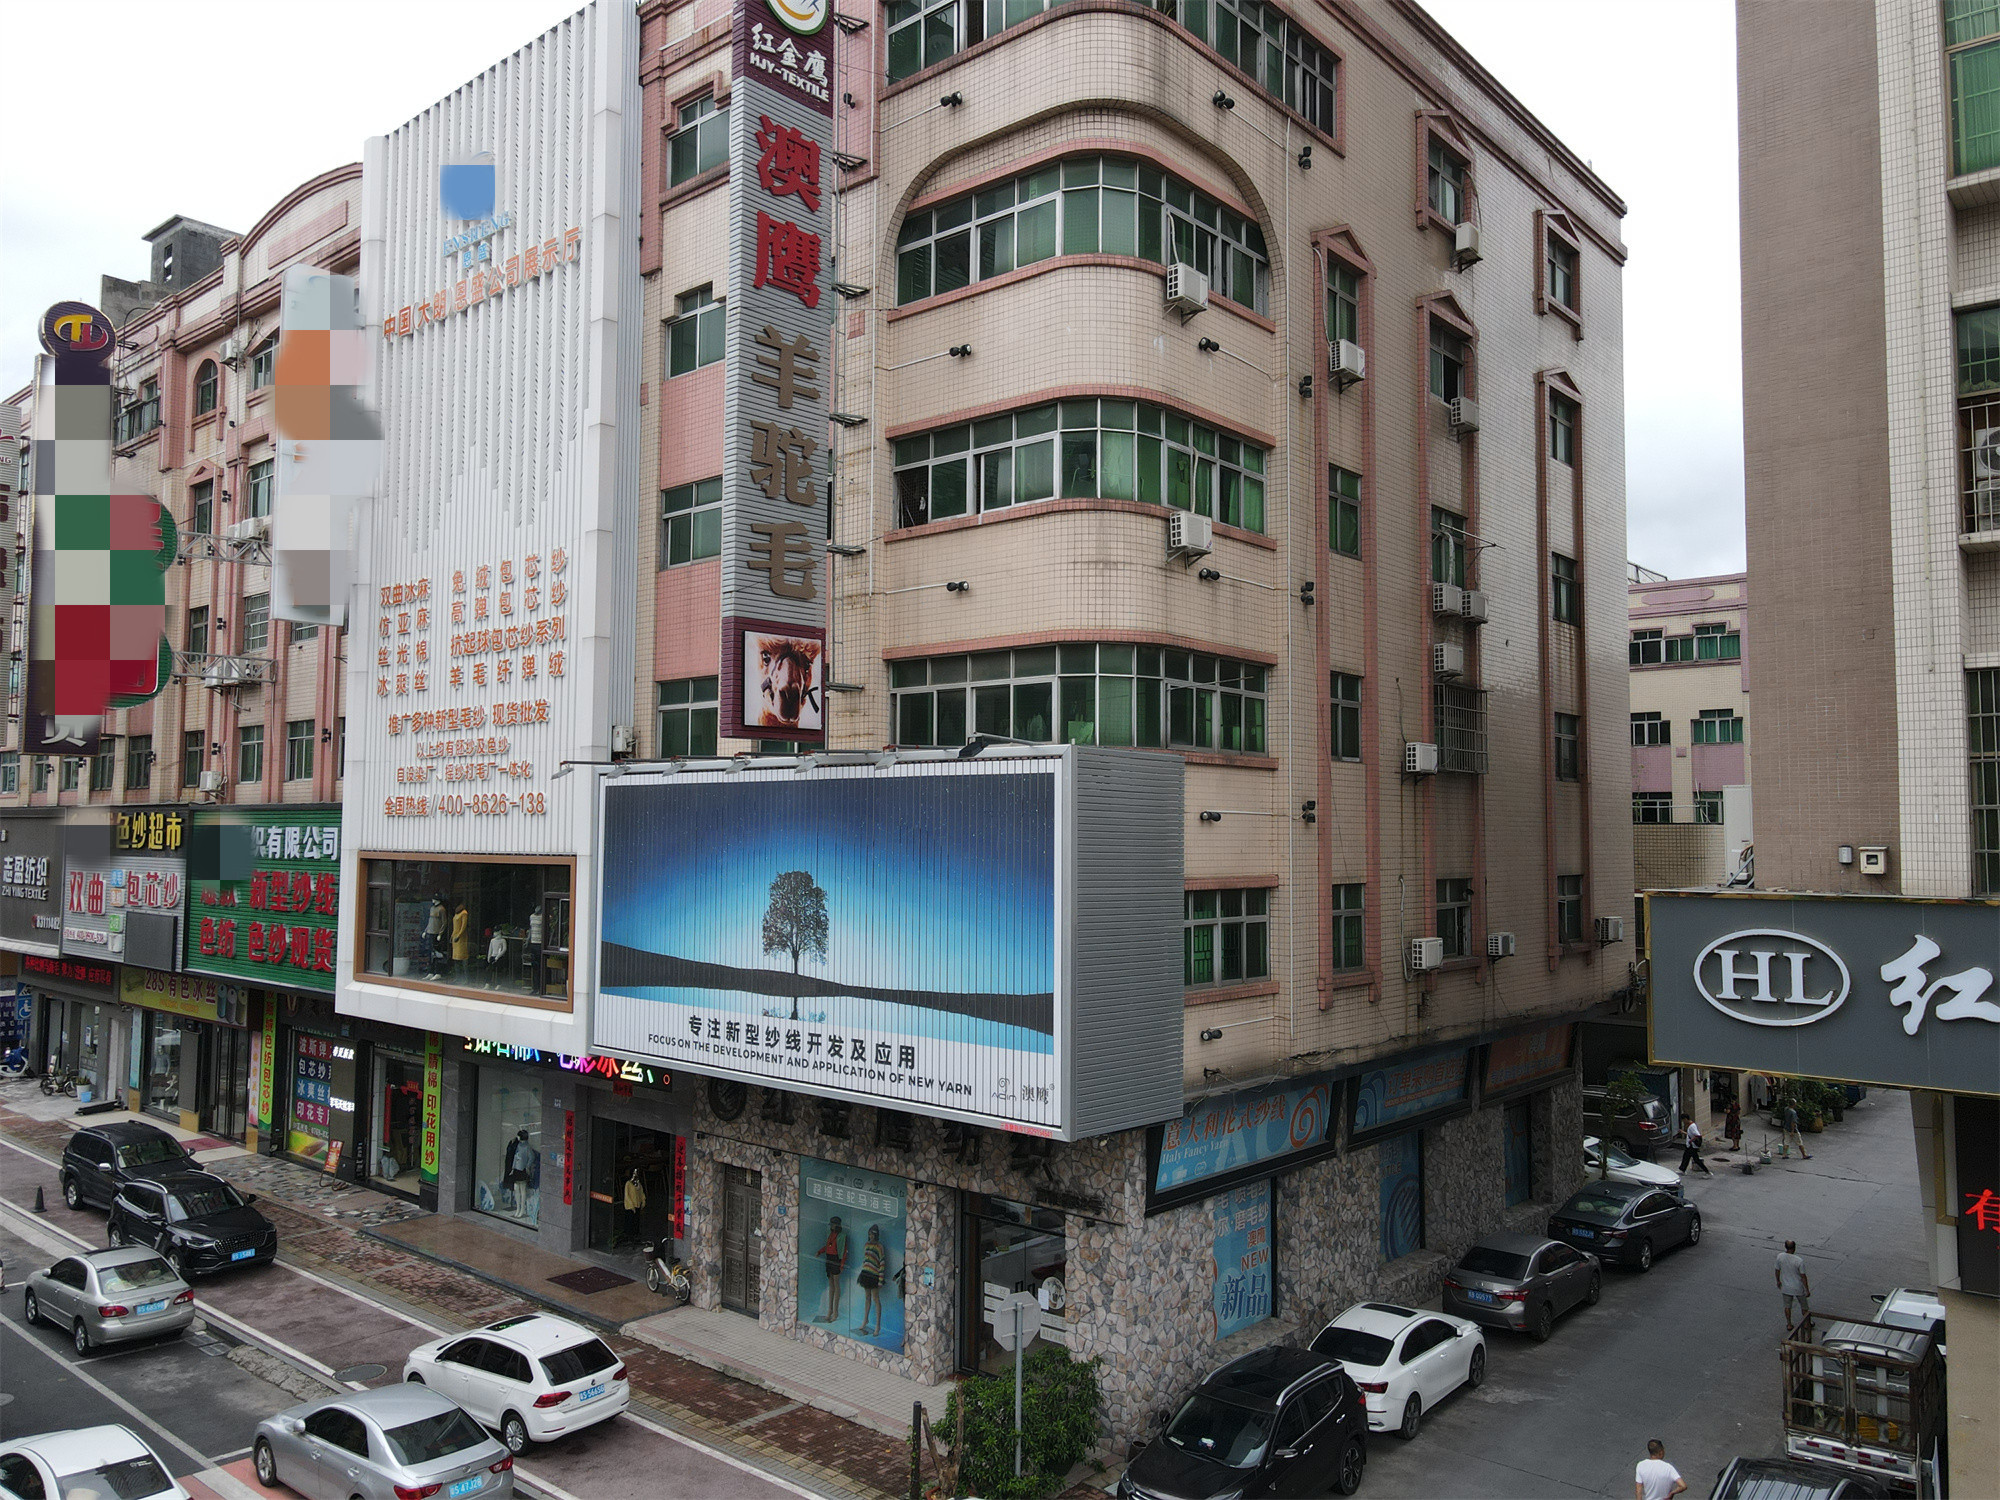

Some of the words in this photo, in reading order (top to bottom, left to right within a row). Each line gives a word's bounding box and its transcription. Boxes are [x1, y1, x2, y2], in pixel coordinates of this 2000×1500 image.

[750, 22, 828, 88] 红金鹰
[749, 52, 830, 103] HJY-TEXTILE
[754, 114, 822, 308] 澳鹰
[443, 211, 510, 256] ENSHENG
[463, 241, 491, 269] 恩盛
[747, 323, 821, 600] 羊驼毛
[380, 577, 432, 607] 双曲冰麻
[451, 581, 568, 625] 高弹包芯纱
[379, 607, 431, 638] 仿亚麻
[450, 615, 566, 658] 抗起球包芯纱系列
[378, 639, 430, 668] 丝光棉
[377, 669, 428, 698] 冰爽丝
[492, 698, 550, 727] 现货批发
[69, 871, 106, 915] 双曲
[127, 871, 182, 909] 包芯纱
[250, 869, 337, 916] 新型纱线
[248, 921, 335, 972] 色纱现货
[145, 969, 165, 992] 28S
[167, 976, 218, 1005] 有色冰丝
[1713, 948, 1834, 1006] HL
[1880, 933, 2000, 1036] 红
[688, 1014, 916, 1071] 专注新型纱线开发及应用
[648, 1033, 677, 1048] FOCUS
[678, 1038, 691, 1050] ON
[693, 1040, 712, 1053] THE
[713, 1043, 785, 1066] DEVELOPMENT
[787, 1055, 810, 1070] AND
[812, 1058, 888, 1083] APPLICATION
[889, 1071, 906, 1085] OF
[908, 1073, 935, 1089] NEW
[937, 1078, 973, 1098] YARN
[1163, 1094, 1287, 1151] 意大利花式纱线
[1184, 1144, 1208, 1159] Fancy
[1241, 1247, 1270, 1273] NEW
[1220, 1273, 1269, 1320] 新品
